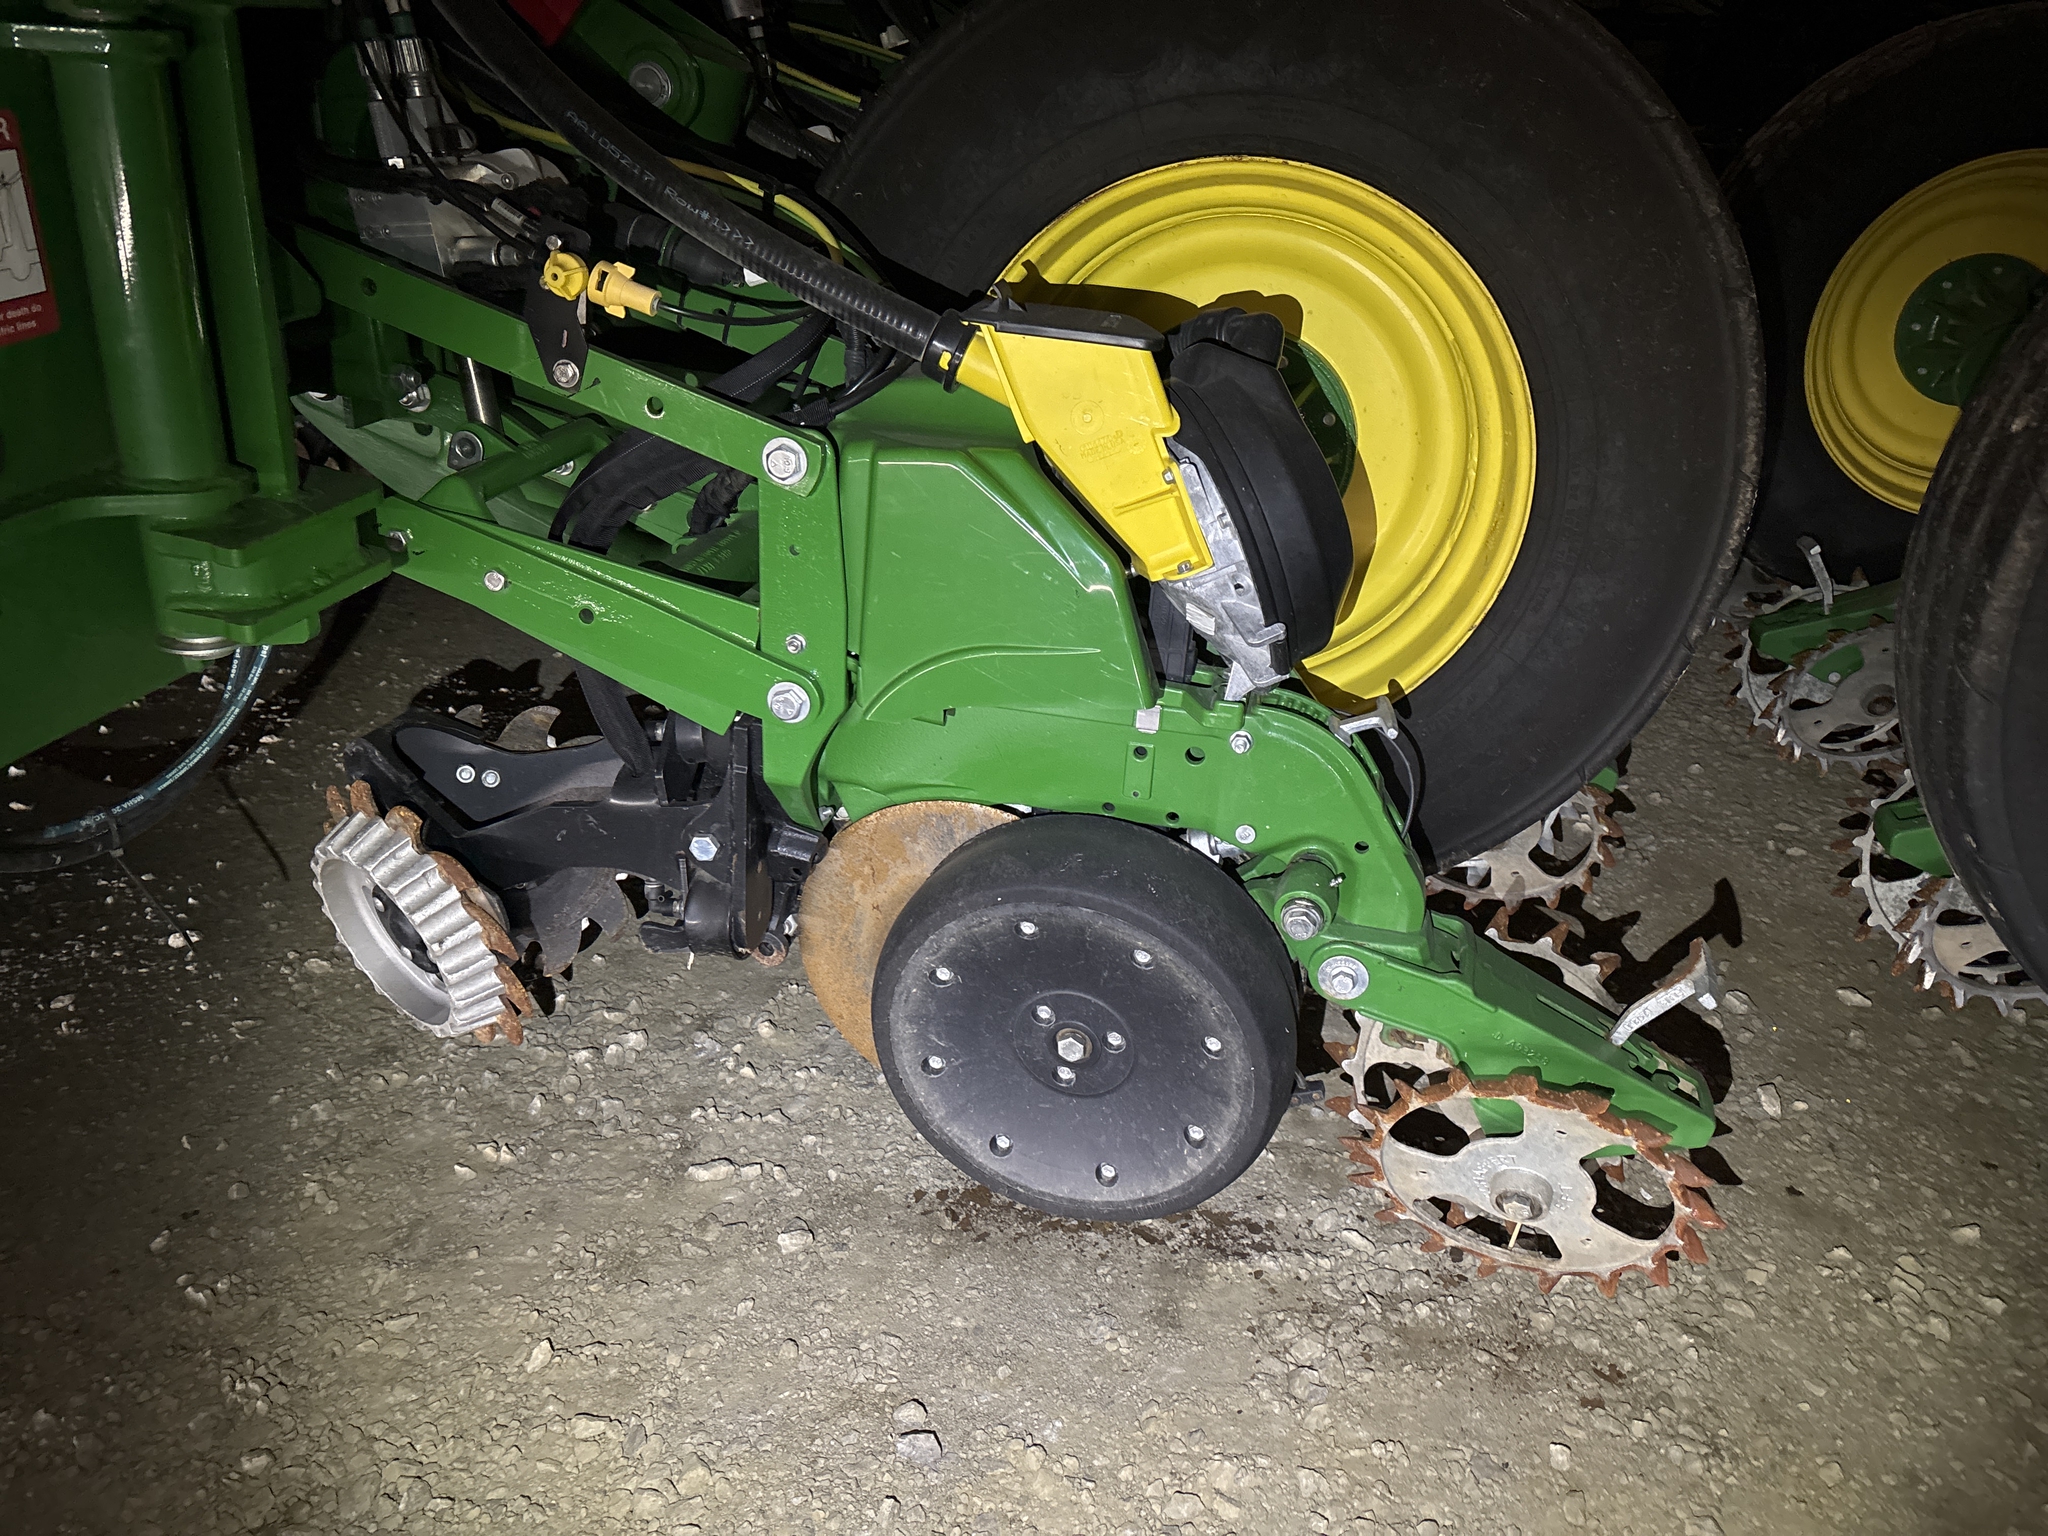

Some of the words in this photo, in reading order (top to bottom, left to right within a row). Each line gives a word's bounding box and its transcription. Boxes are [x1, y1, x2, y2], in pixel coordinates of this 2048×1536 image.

[6, 307, 28, 318] death
[31, 304, 41, 312] do
[121, 794, 144, 809] MSHA
